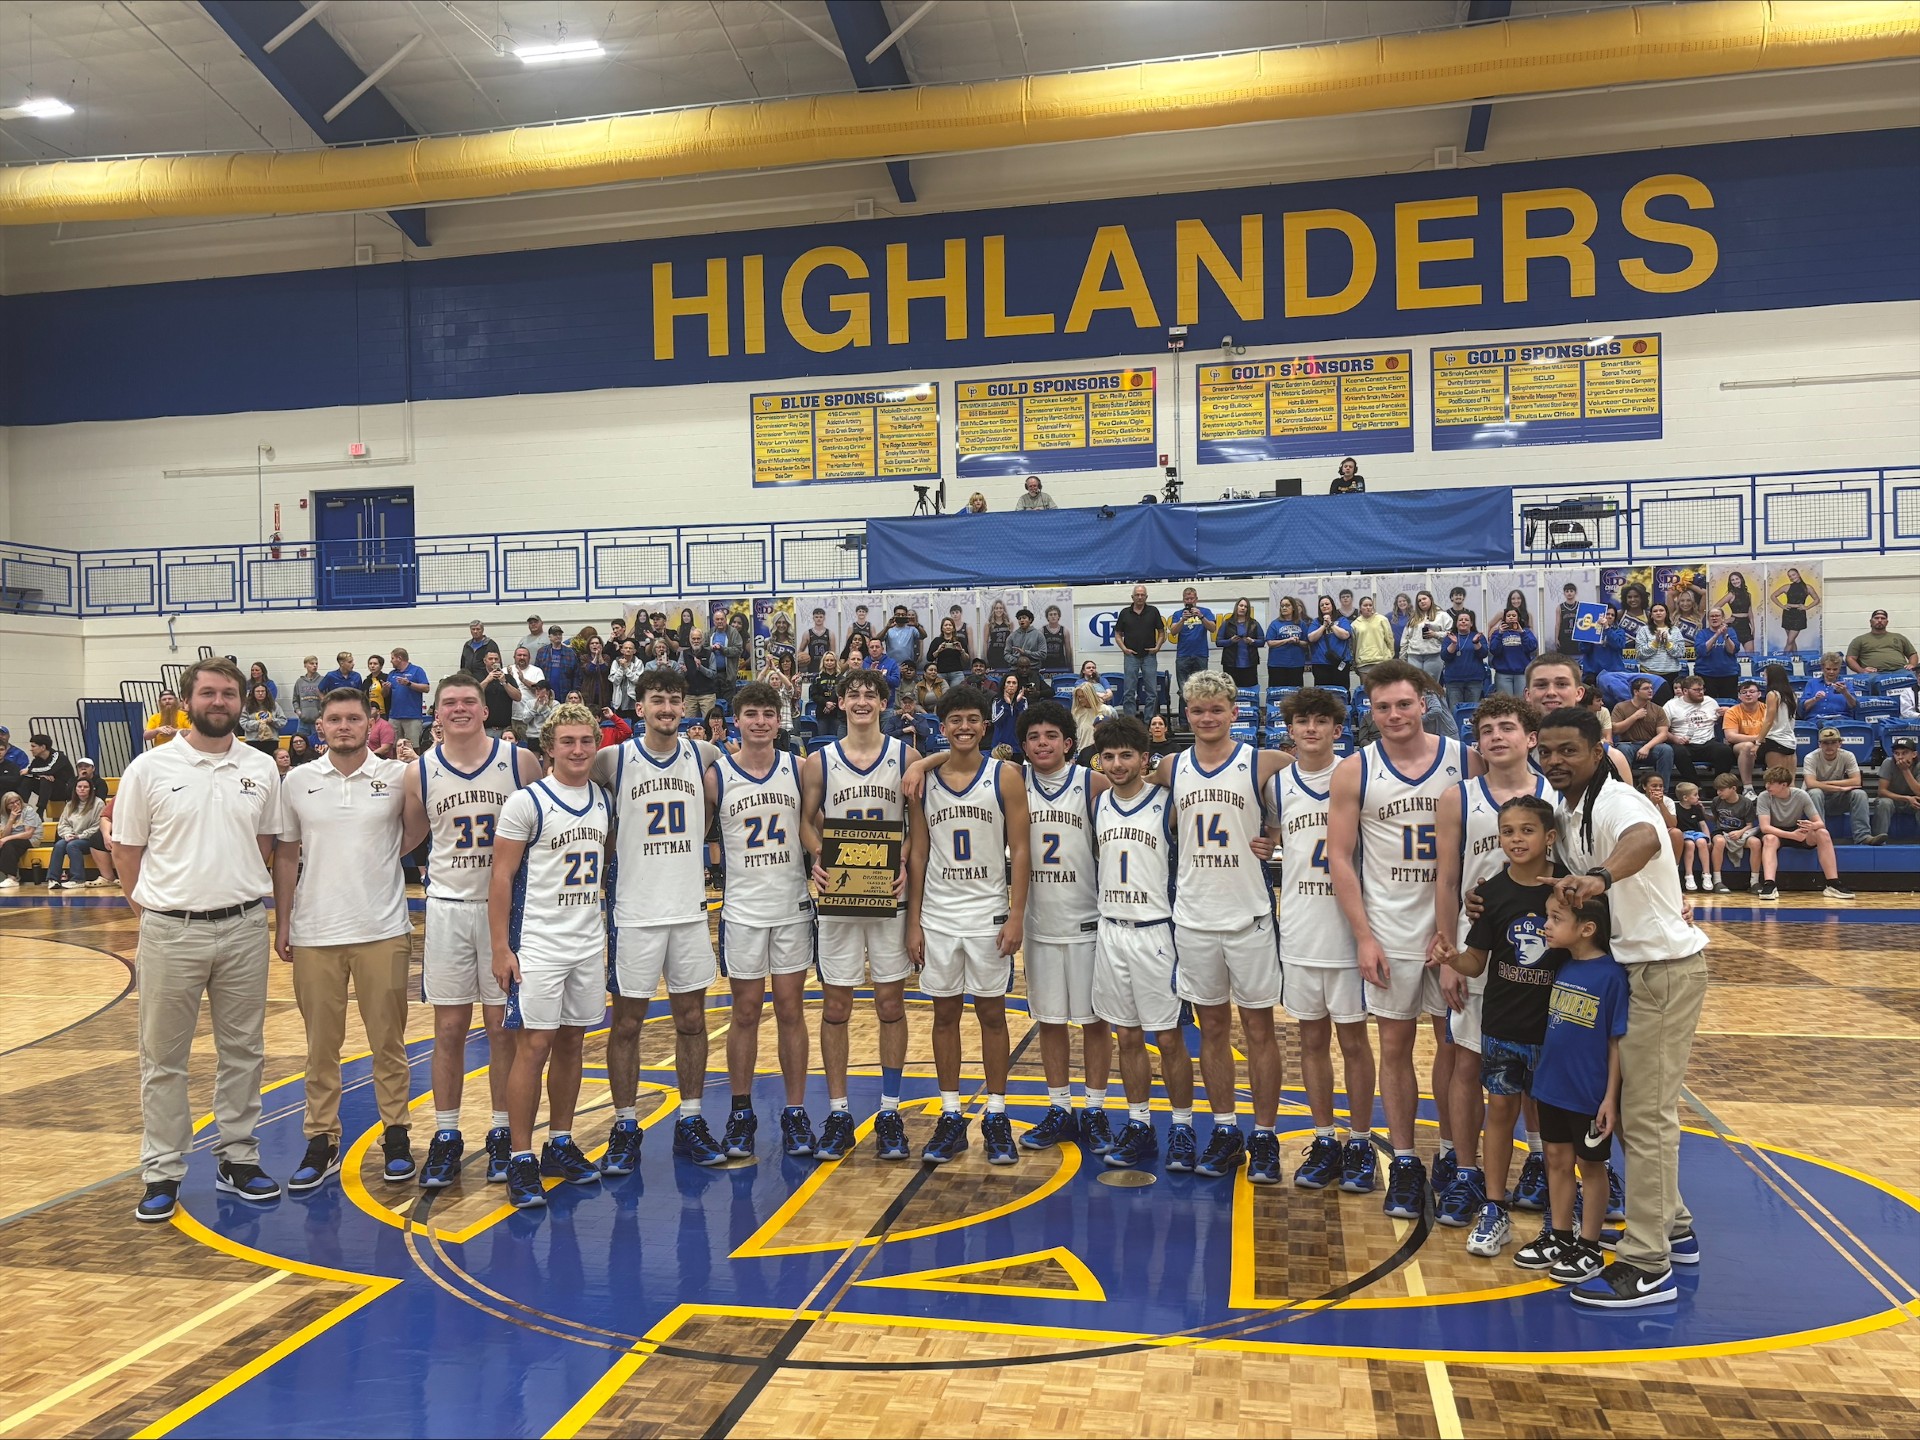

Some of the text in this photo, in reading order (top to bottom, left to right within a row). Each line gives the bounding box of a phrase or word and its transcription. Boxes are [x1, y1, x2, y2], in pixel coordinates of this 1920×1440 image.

[651, 174, 1719, 361] HIGHLANDERS
[1468, 342, 1622, 365] GOLD SPONSORS
[1232, 358, 1374, 380] GOLD SPONSORS
[988, 376, 1120, 398] GOLD SPONSORS
[780, 395, 820, 410] BLUE
[350, 444, 363, 454] EXIT
[1298, 582, 1318, 596] 25
[1353, 576, 1371, 590] 33
[1463, 574, 1481, 587] 20
[1518, 573, 1536, 588] 12
[823, 598, 837, 608] 14
[868, 596, 883, 608] 22
[960, 594, 976, 606] 24
[1006, 592, 1024, 607] 21
[1056, 590, 1072, 602] 23
[631, 776, 696, 800] GATLINBURG
[832, 784, 896, 806] GATLINBURG
[730, 792, 796, 817] GATLINBURG
[1180, 788, 1245, 812] GATLINBURG
[646, 800, 687, 836] 20
[929, 805, 993, 828] GATLINBURG
[1029, 810, 1082, 830] ATLINBURG
[1288, 812, 1328, 836] GATLIN
[453, 814, 496, 850] 33
[551, 826, 606, 851] GATLINBUR
[744, 812, 786, 850] 24
[832, 830, 892, 840] REGIONAL
[1098, 826, 1158, 850] GATLINBURG
[1196, 812, 1230, 848] 14
[642, 840, 692, 856] PITTMAN
[952, 828, 972, 862] 0
[1042, 832, 1061, 865] 2
[1402, 823, 1437, 861] 15
[451, 854, 494, 868] PITTMA
[744, 850, 790, 868] PITTMAN
[1310, 838, 1330, 874] 4
[564, 851, 598, 886] 23
[942, 866, 988, 880] PITTMAN
[1030, 870, 1076, 884] PITTMAN
[1120, 850, 1129, 884] 1
[1391, 866, 1438, 883] PITTMA
[558, 891, 598, 906] PITTMA
[1104, 890, 1148, 904] PITTMAN
[1298, 881, 1336, 896] PITTM
[824, 896, 892, 907] CHAMPIONS
[1522, 920, 1534, 934] CP
[1498, 961, 1554, 985] BASKETBA
